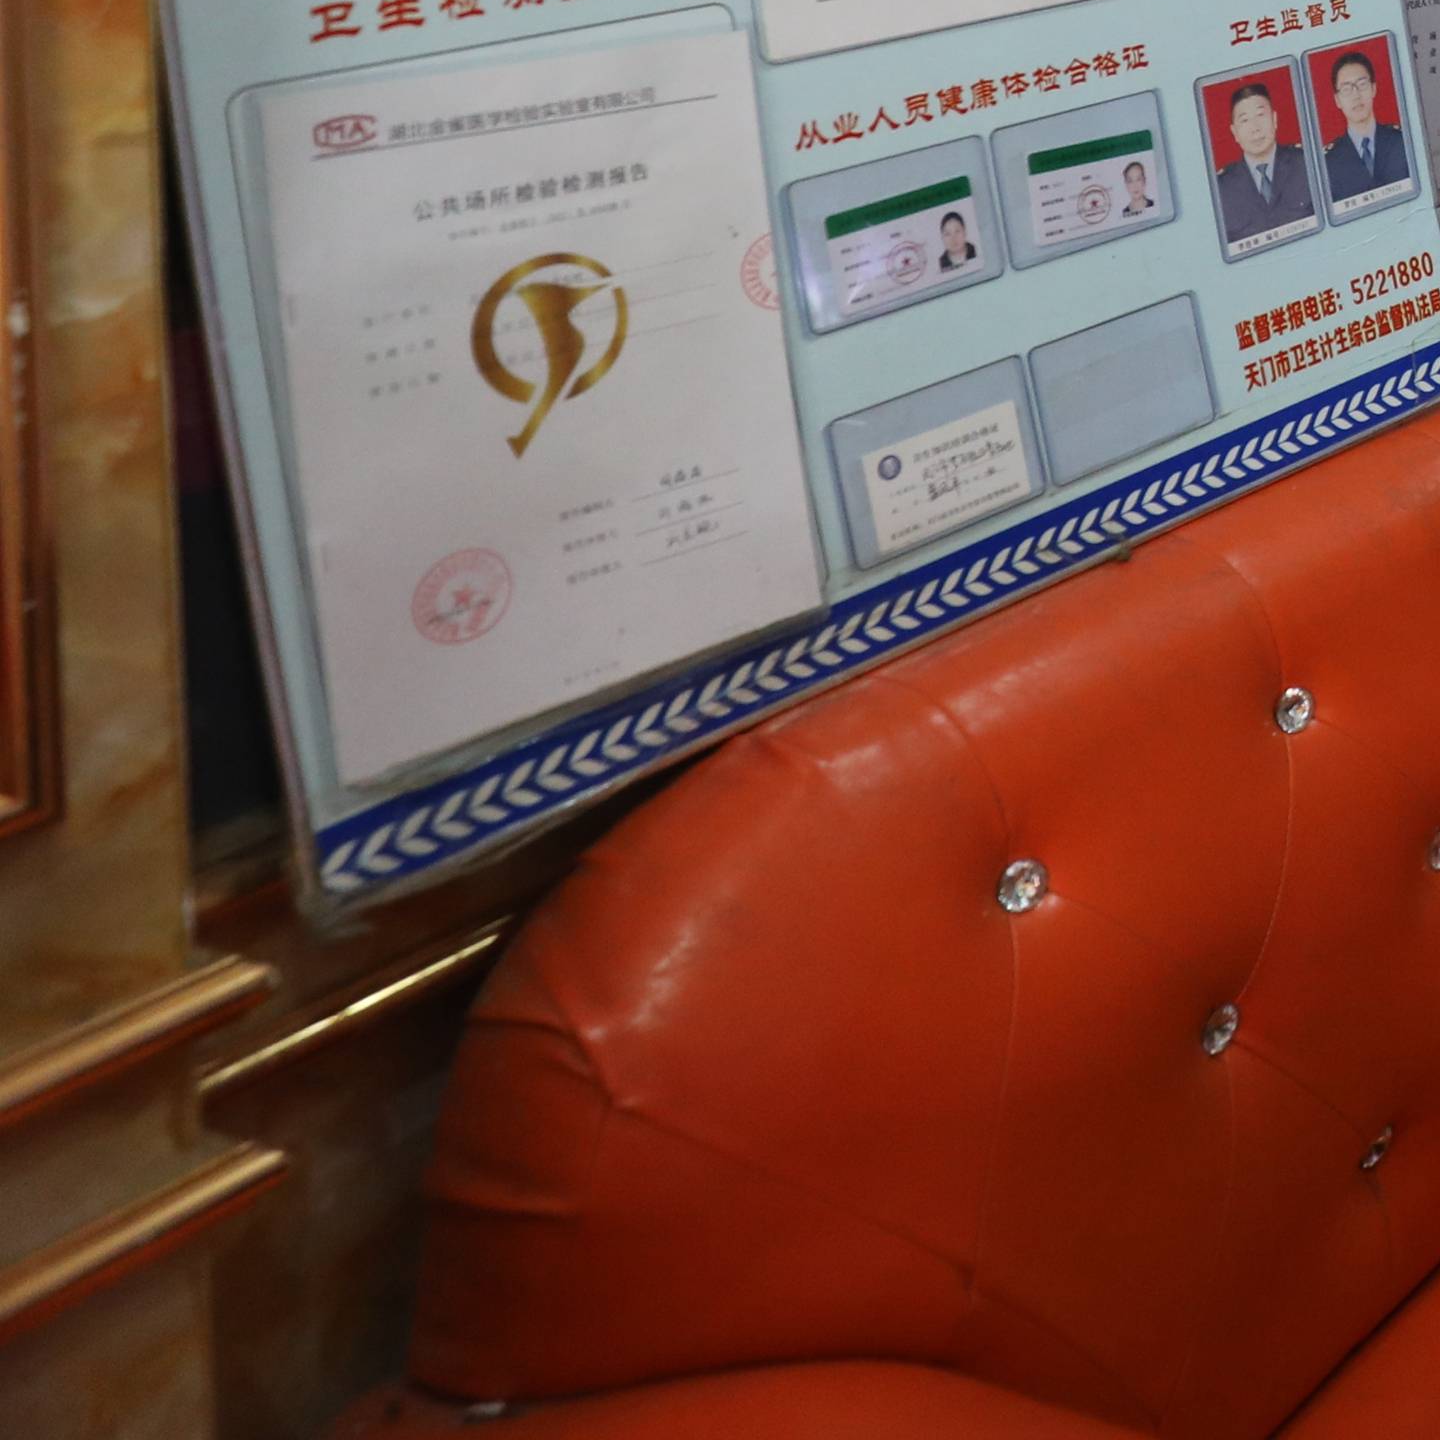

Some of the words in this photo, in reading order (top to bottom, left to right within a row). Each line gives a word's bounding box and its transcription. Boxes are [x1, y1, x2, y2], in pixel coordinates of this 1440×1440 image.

[794, 43, 1150, 152] 从业人员健康体检合格证
[413, 162, 649, 223] 公共场所检验检测报告
[1234, 288, 1344, 351] 监督举报电话：
[1350, 251, 1435, 306] 5221880
